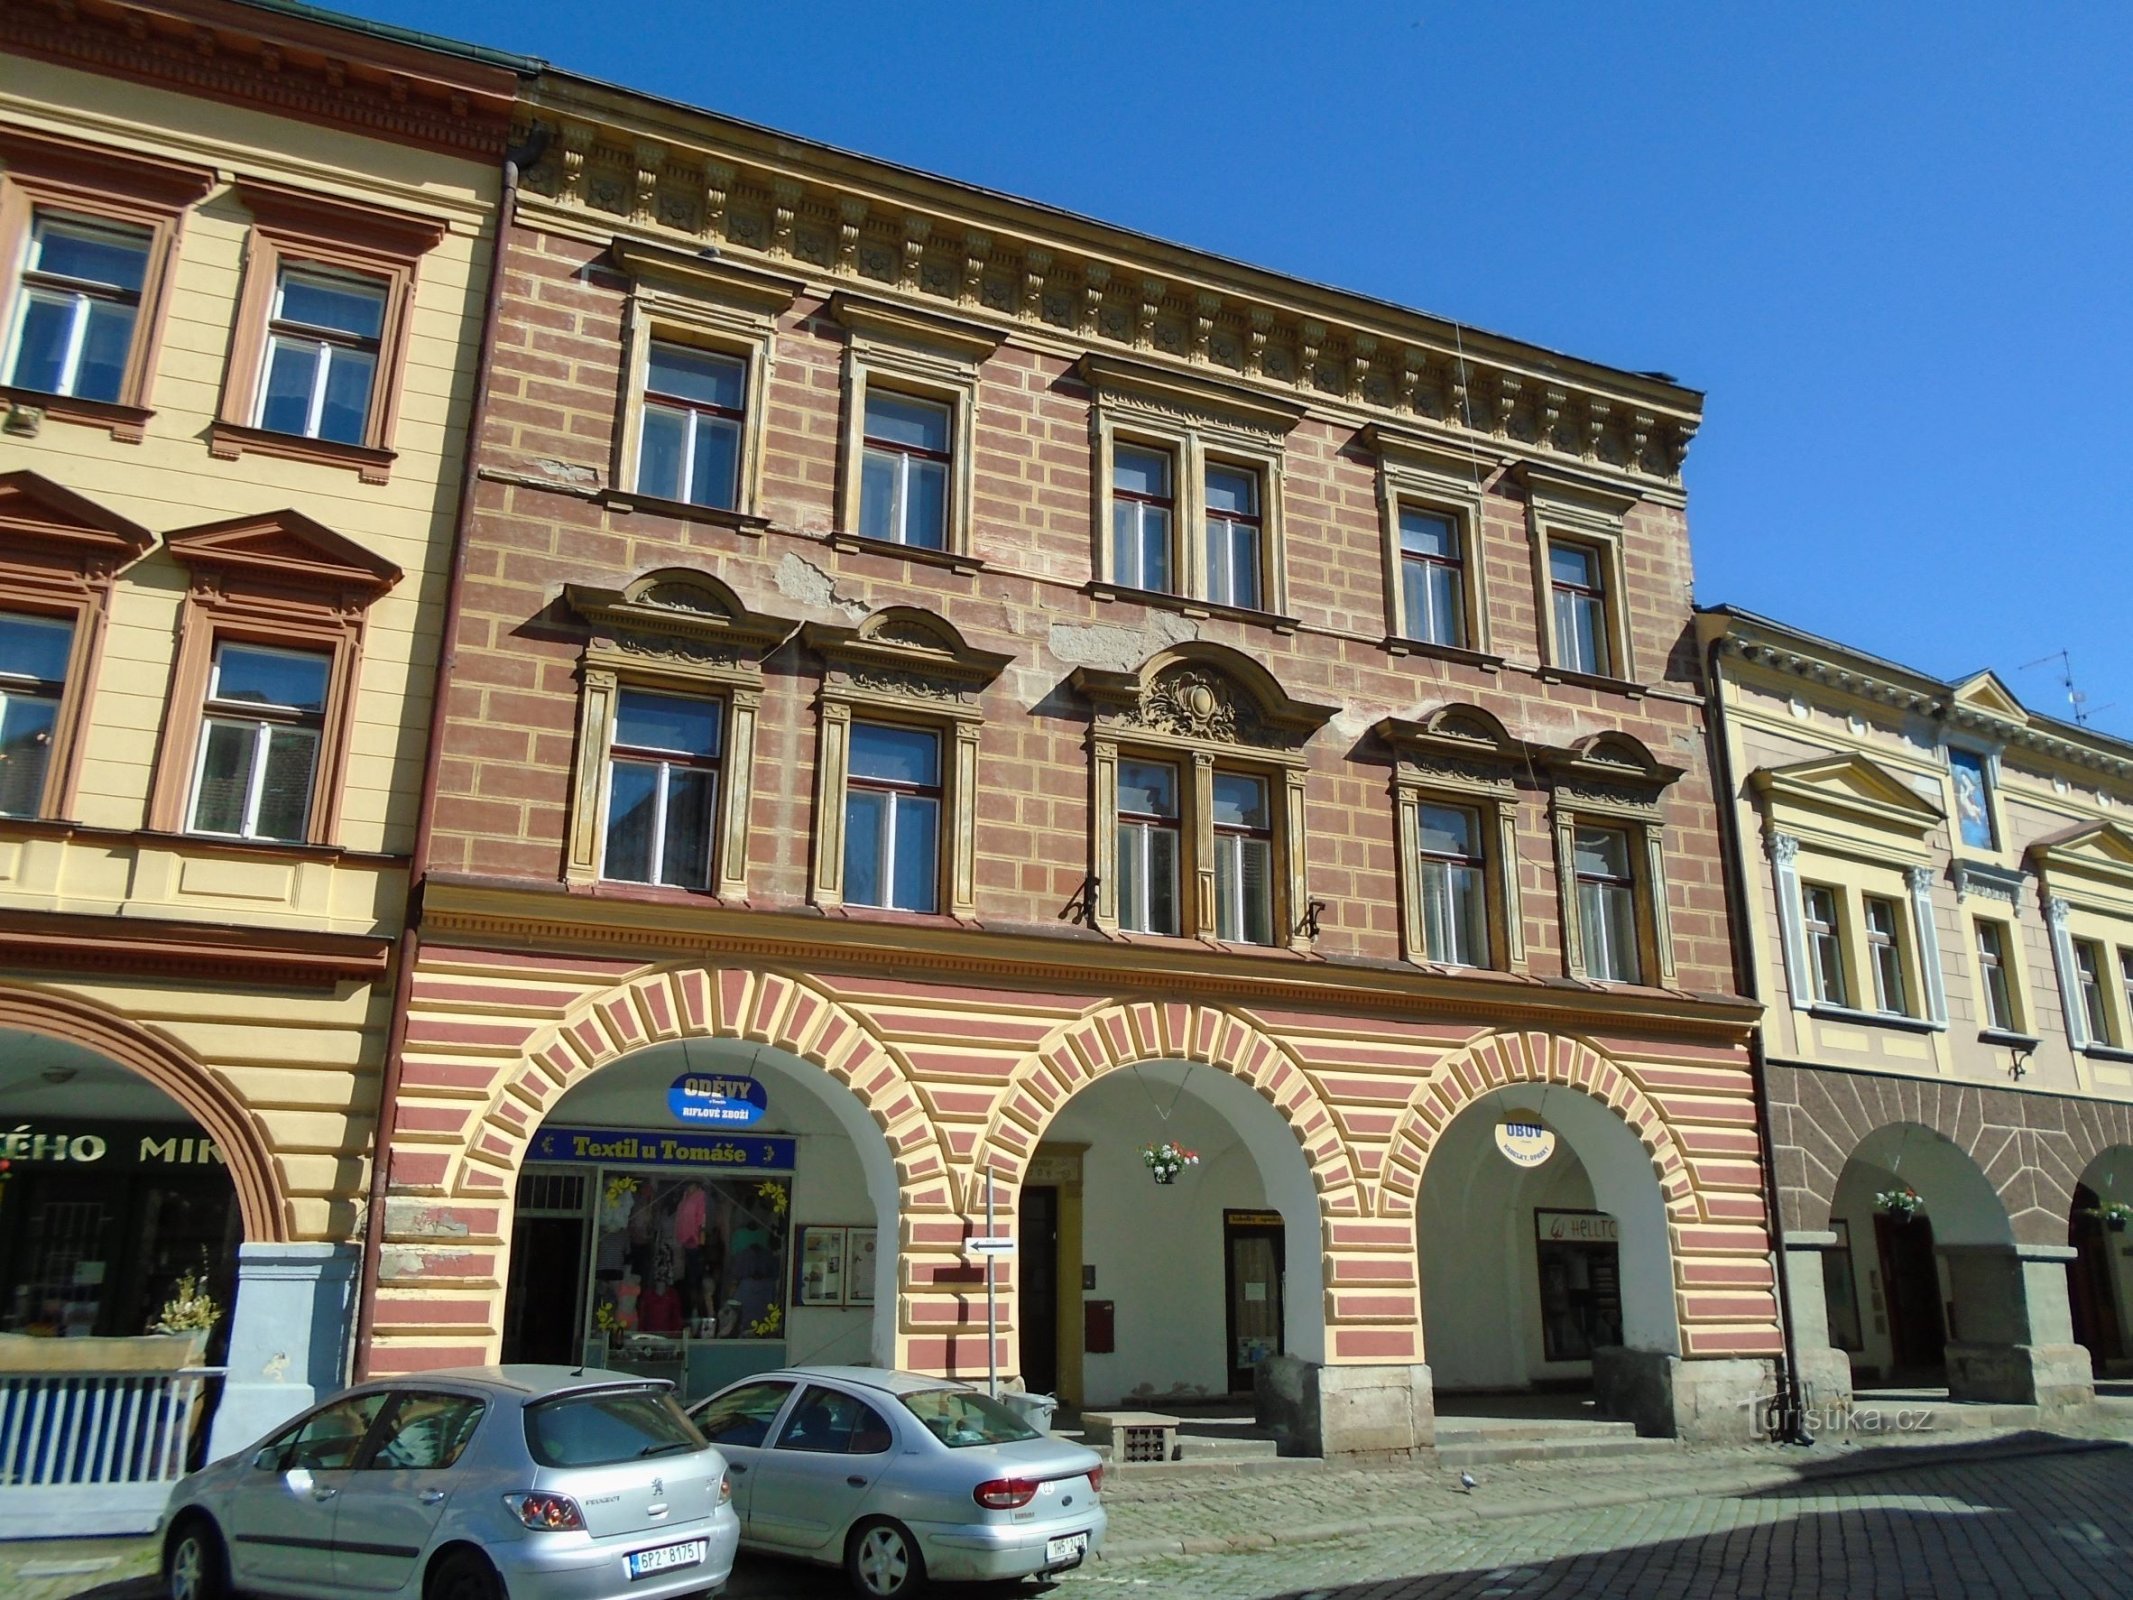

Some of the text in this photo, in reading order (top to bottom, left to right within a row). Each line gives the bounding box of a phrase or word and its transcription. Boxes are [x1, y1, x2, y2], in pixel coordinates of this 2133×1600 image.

[684, 1076, 751, 1099] ODĚVY
[683, 1107, 749, 1119] RIFLOVÉ ZBOŽÍ
[1506, 1122, 1542, 1137] OBUV
[0, 1125, 106, 1161] ÉHO
[573, 1136, 747, 1162] Textil u Tomáše
[641, 1543, 694, 1568] 6P2 8175
